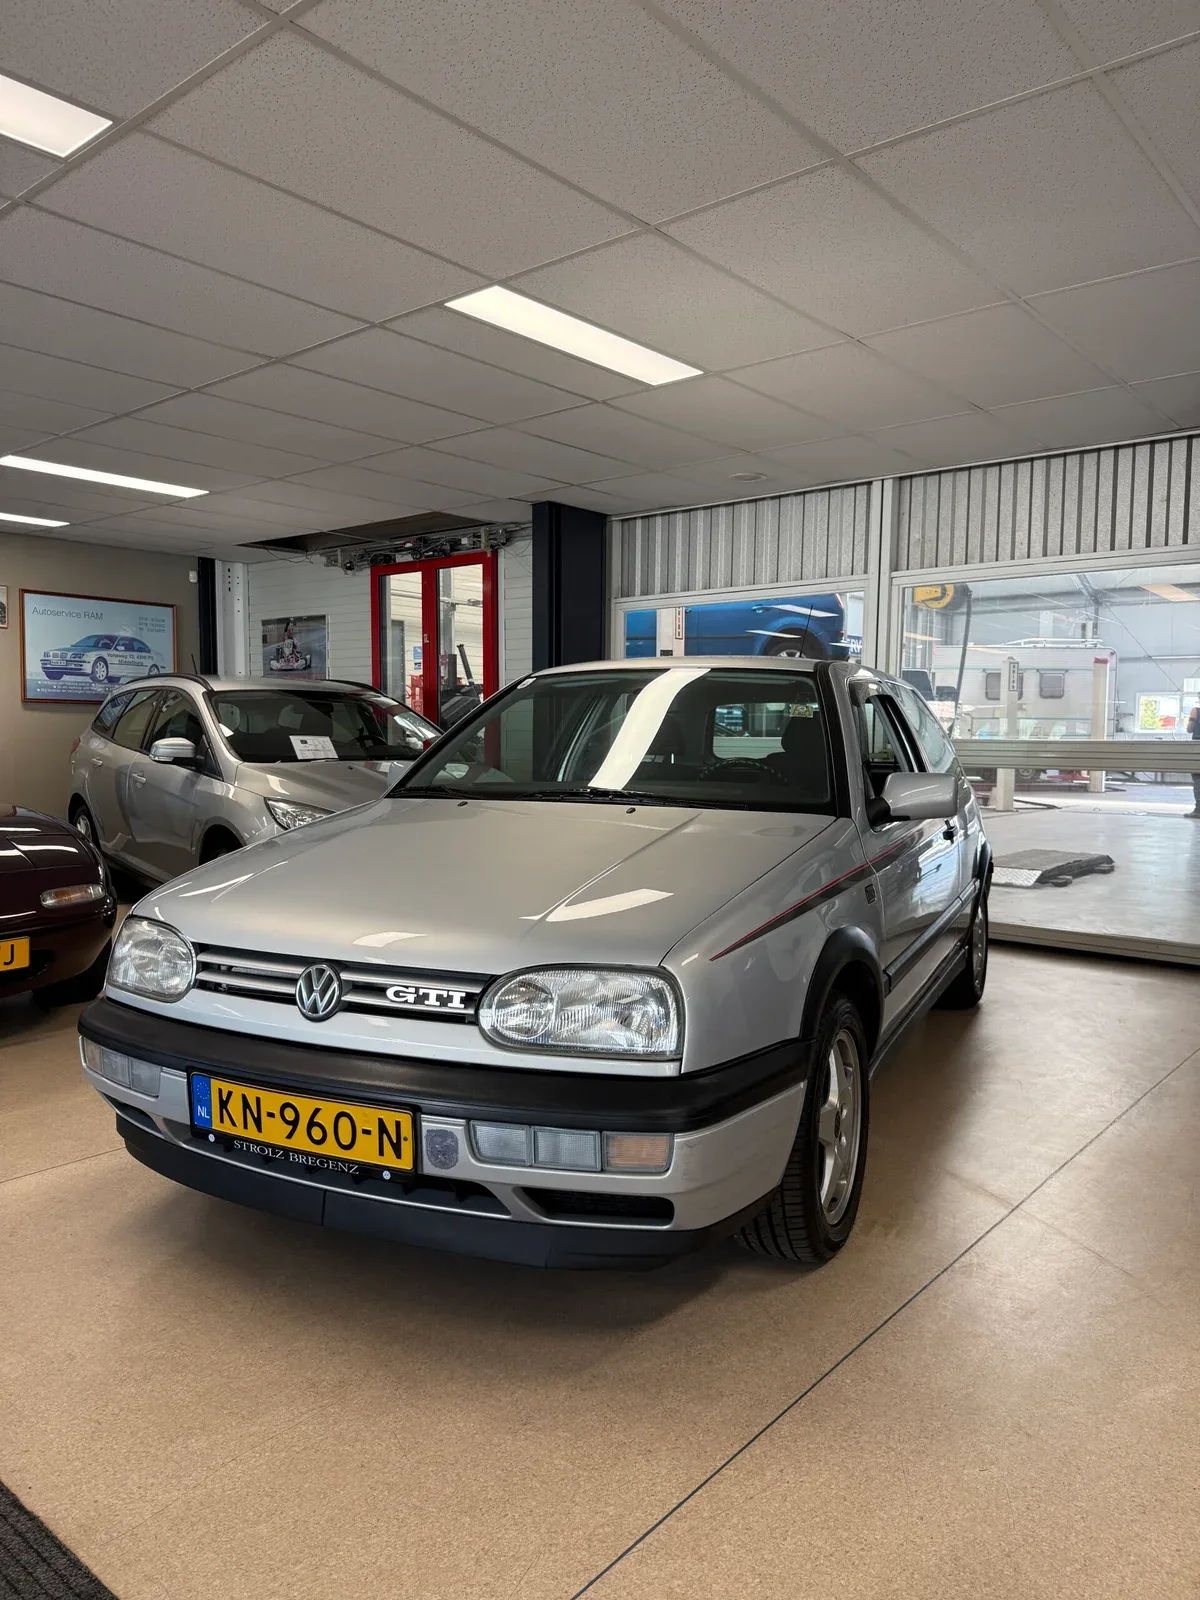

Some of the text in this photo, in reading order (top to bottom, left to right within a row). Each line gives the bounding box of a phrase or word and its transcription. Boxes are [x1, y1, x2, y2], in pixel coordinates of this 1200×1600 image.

[31, 606, 104, 620] Autoservice RAM
[385, 986, 466, 1009] GTI
[197, 1105, 210, 1119] NL
[217, 1087, 403, 1160] KN-960-N
[233, 1139, 360, 1175] STROLZ BREGENZ
